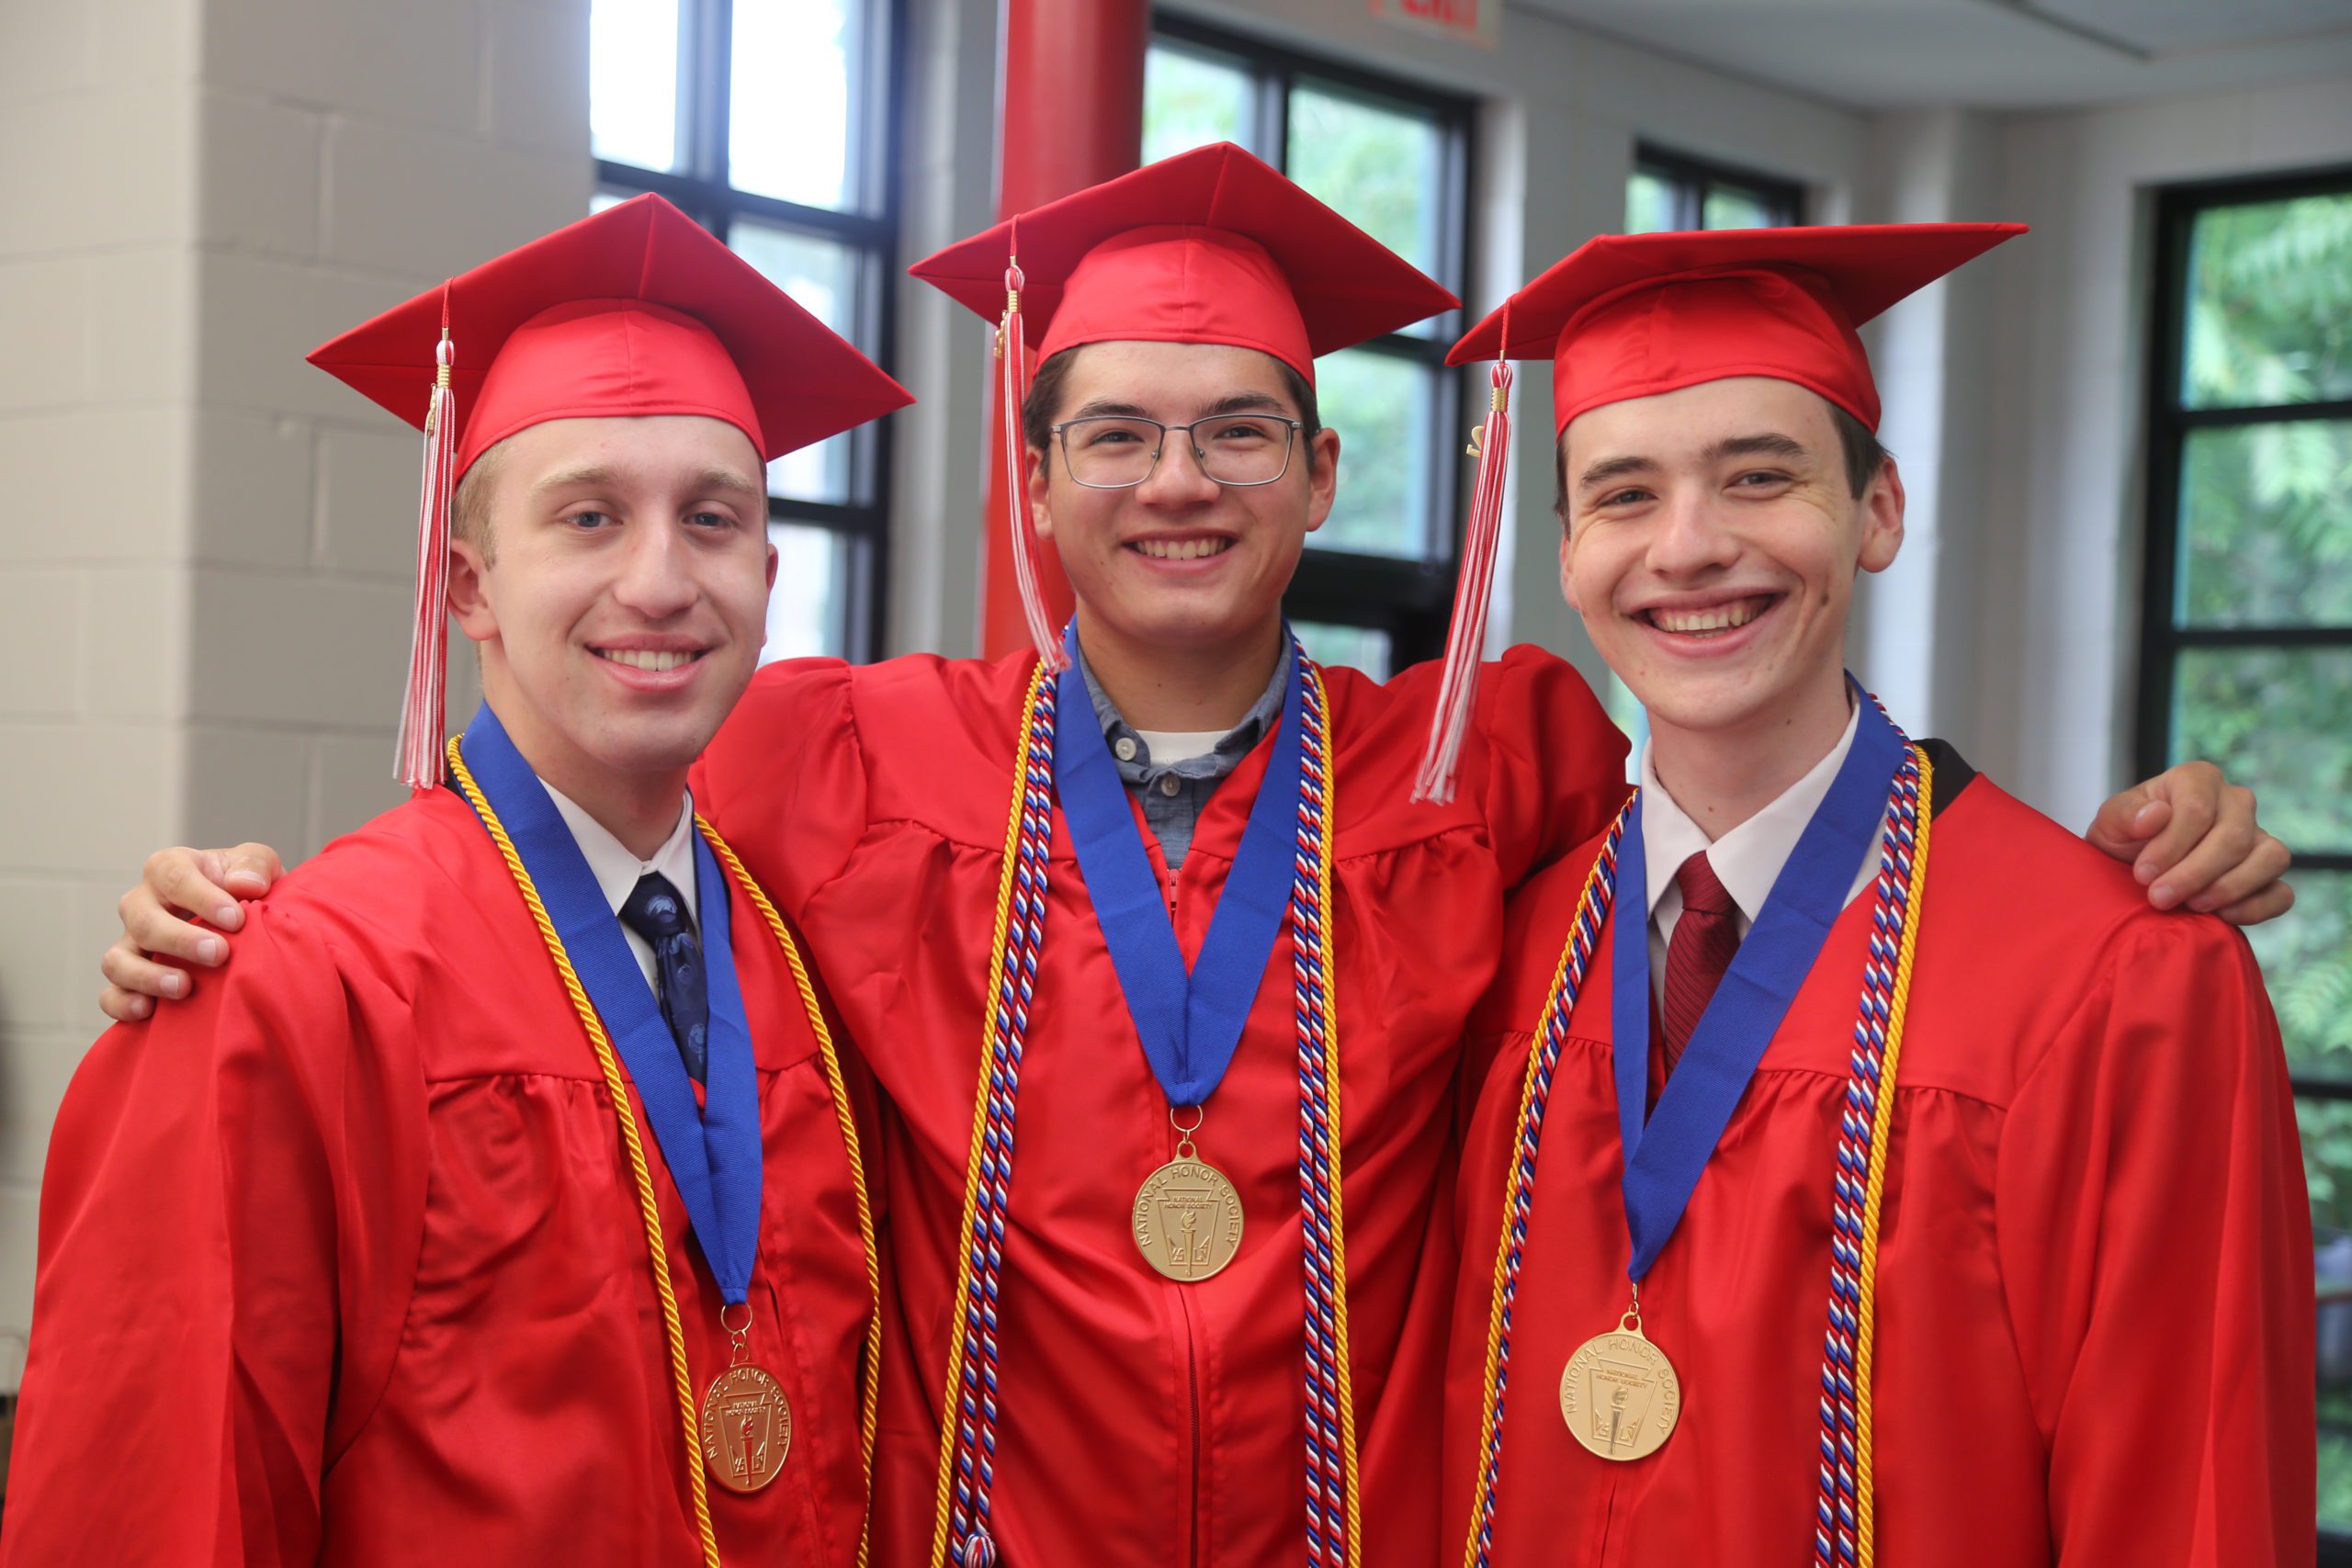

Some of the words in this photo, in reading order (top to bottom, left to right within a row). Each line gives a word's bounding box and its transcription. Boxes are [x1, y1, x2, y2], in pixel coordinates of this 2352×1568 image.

[1136, 1175, 1167, 1247] NATIONAL
[1170, 1164, 1219, 1186] HONOR
[1219, 1184, 1240, 1247] SOCIETY
[729, 1368, 770, 1388] HONOR
[770, 1385, 789, 1451] SOCIETY
[1564, 1343, 1603, 1415] NATIONAL
[1608, 1337, 1658, 1366] HONOR
[1657, 1368, 1676, 1435] SOCIETY
